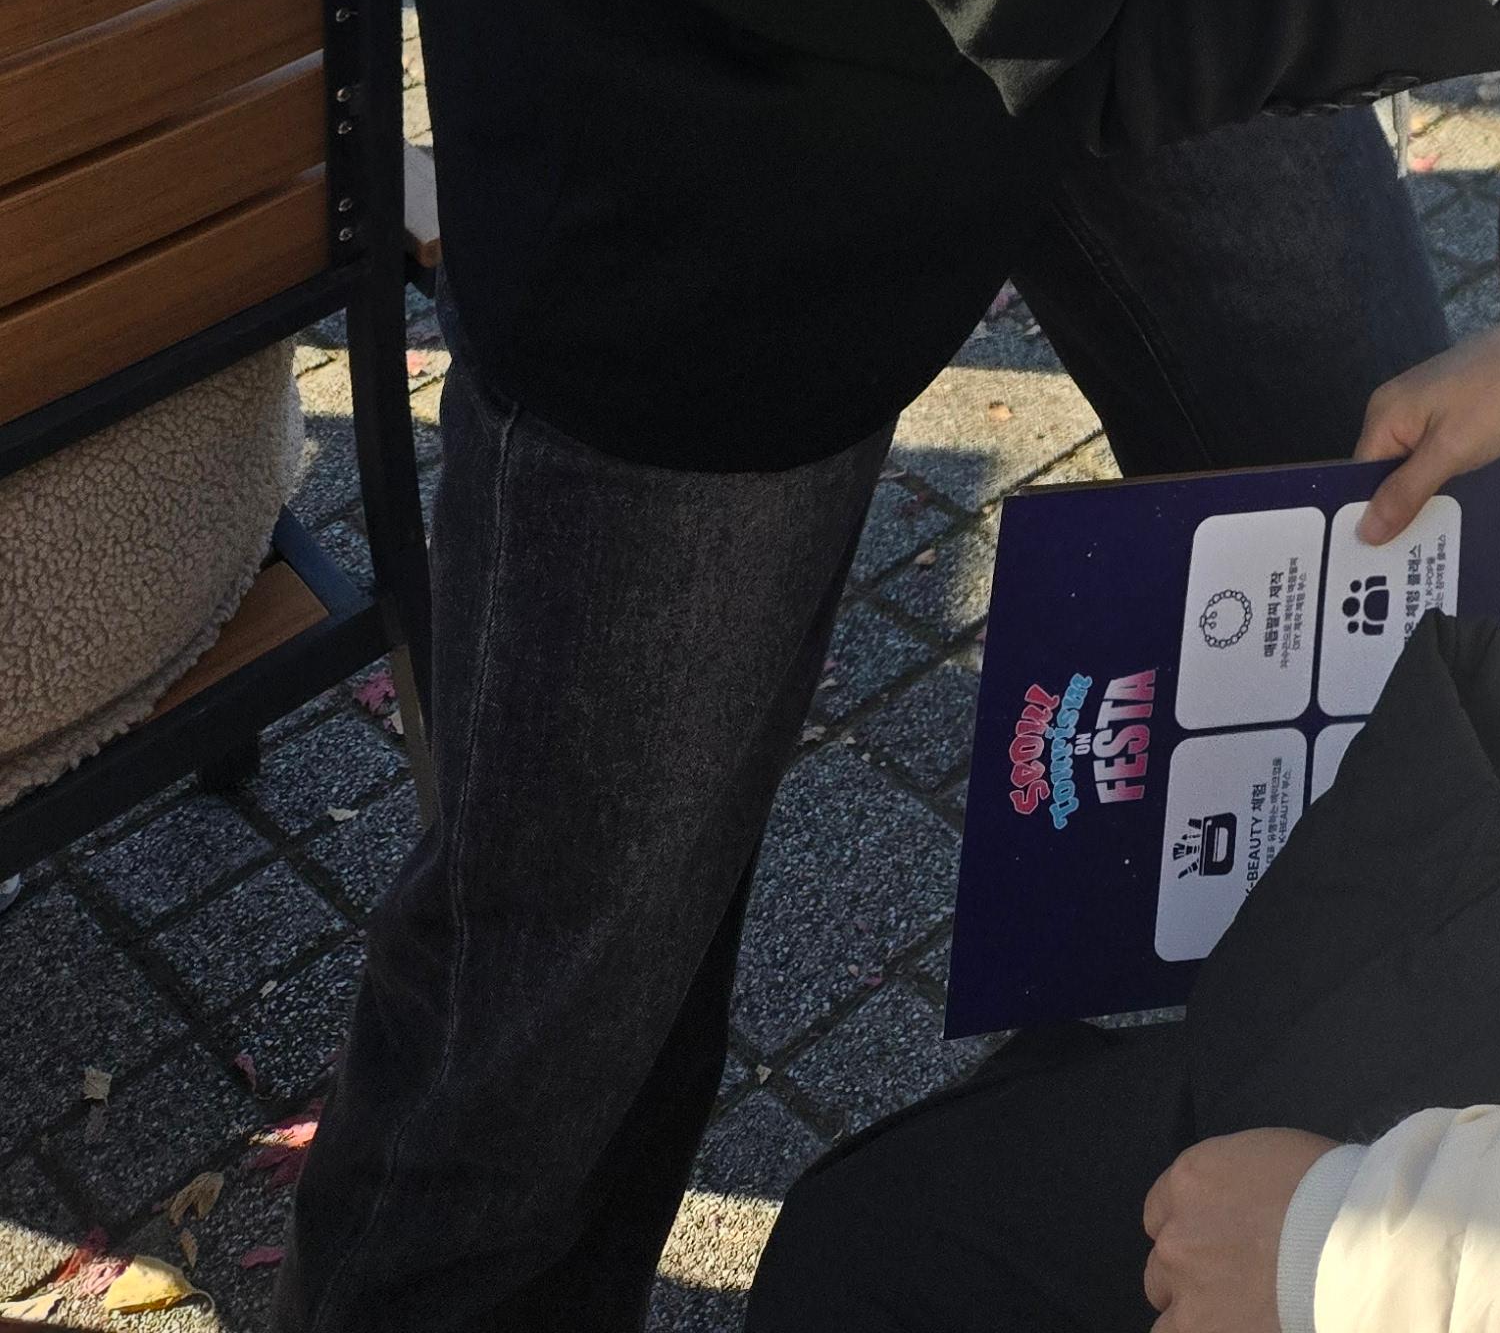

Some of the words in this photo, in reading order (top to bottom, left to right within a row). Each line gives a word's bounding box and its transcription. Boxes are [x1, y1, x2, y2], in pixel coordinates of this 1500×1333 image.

[1437, 533, 1446, 561] 클래스
[1408, 544, 1421, 586] 클래스
[1269, 571, 1284, 599] 제작
[1297, 572, 1307, 591] 부스
[1406, 591, 1420, 617] 체험
[1264, 602, 1281, 658] 매듭팔찌
[1074, 733, 1092, 756] ON
[1092, 669, 1156, 804] FESTA
[1282, 770, 1291, 790] 부스
[1251, 783, 1266, 811] 체험
[1279, 792, 1289, 844] K-BEAUTY
